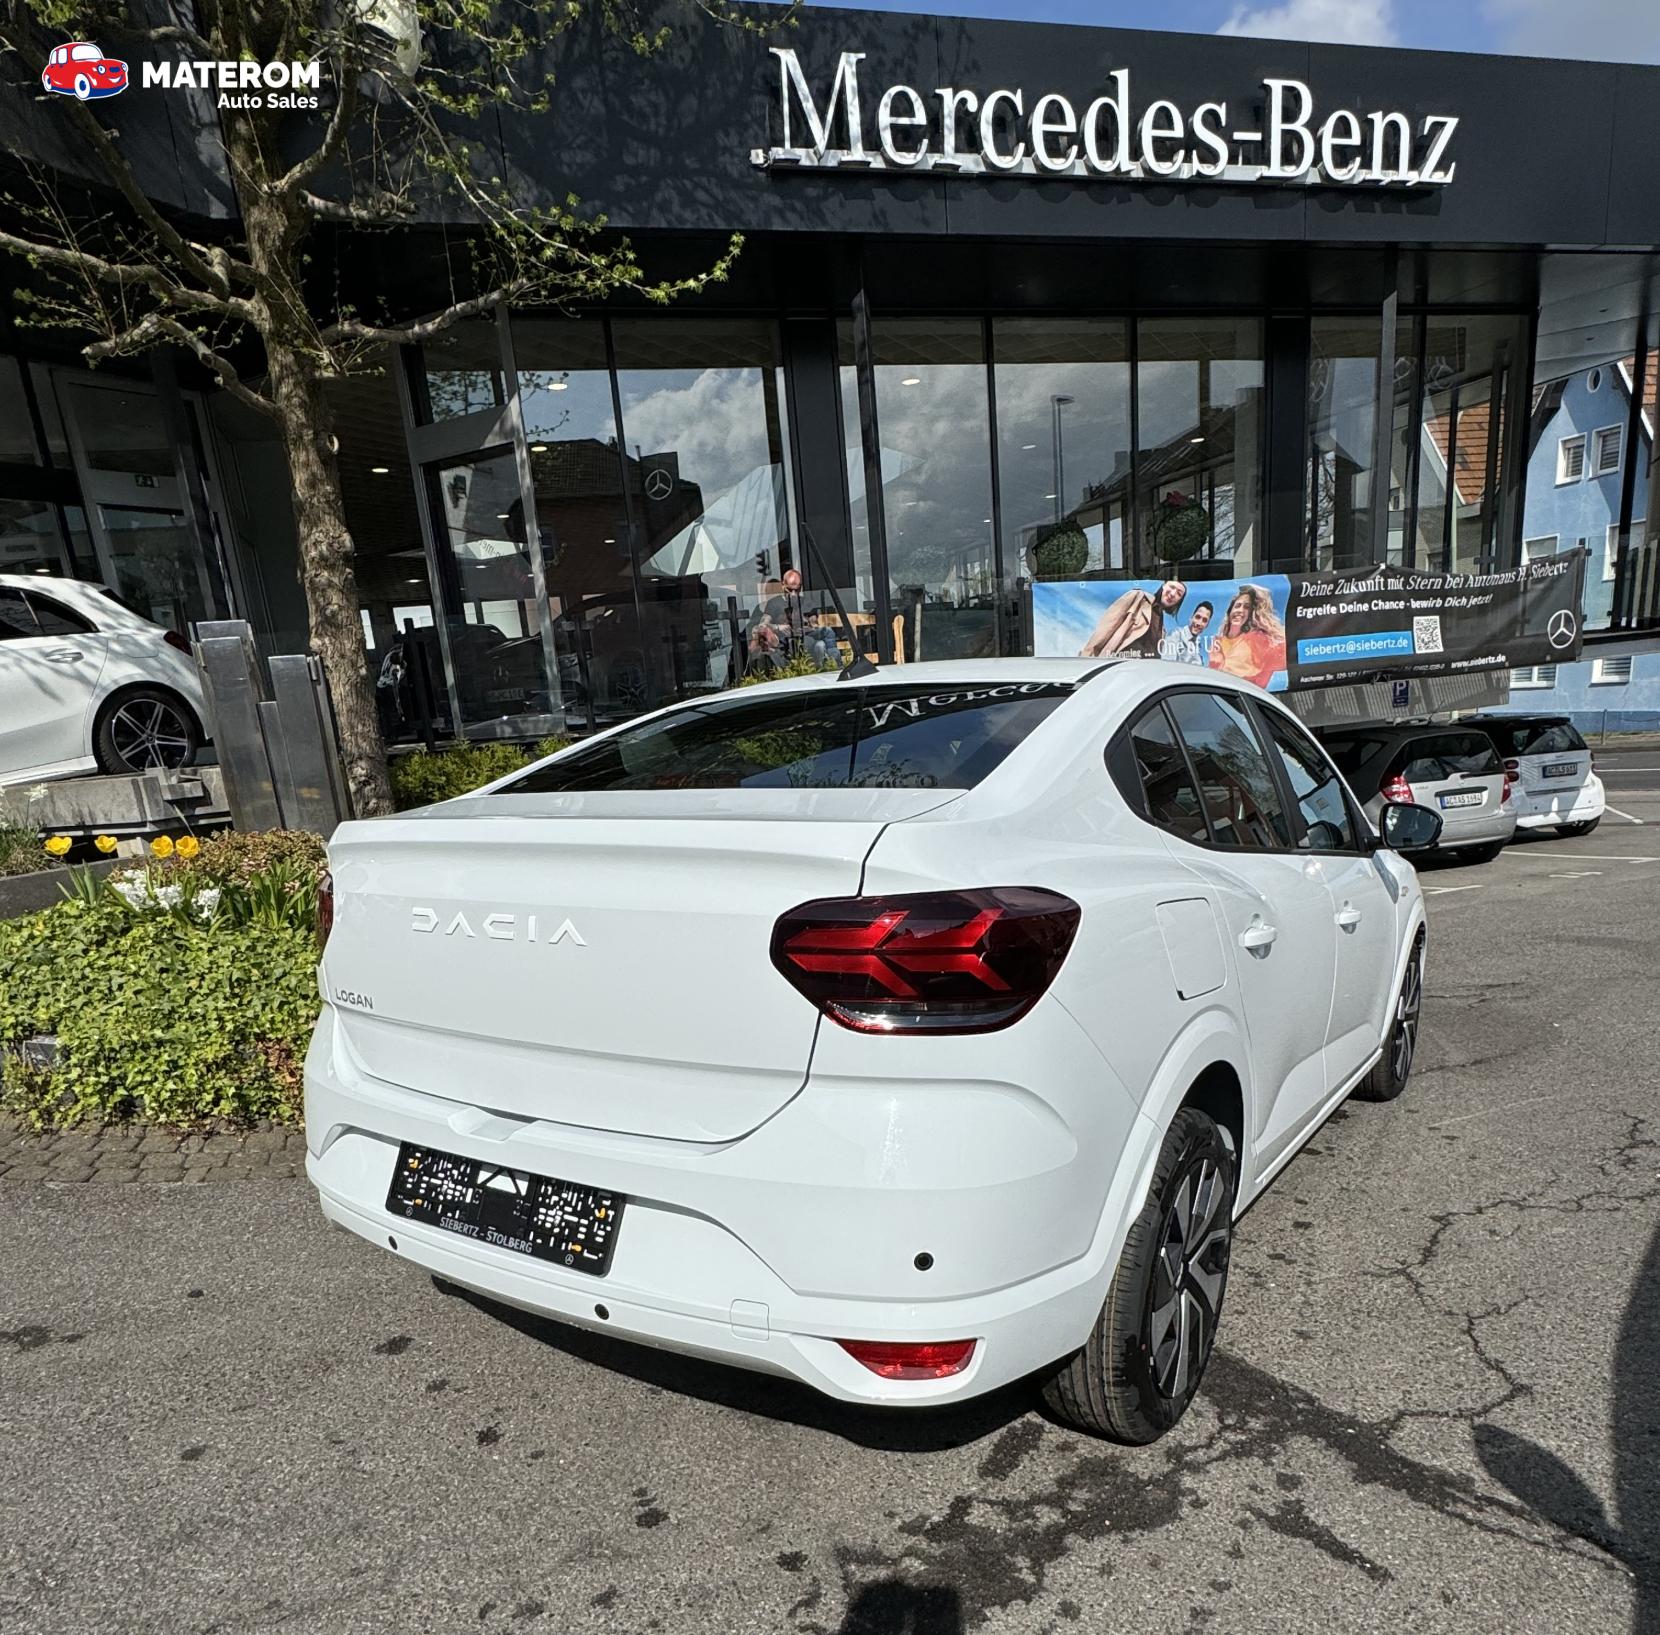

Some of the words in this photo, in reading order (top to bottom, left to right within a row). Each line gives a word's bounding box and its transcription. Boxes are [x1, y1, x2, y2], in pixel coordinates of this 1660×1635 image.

[769, 47, 1459, 184] Mercedes-Benz
[1300, 580, 1334, 598] Deine
[1335, 575, 1385, 595] Zukunft
[1387, 574, 1405, 591] mit
[1407, 575, 1442, 593] Stern
[1444, 574, 1464, 590] bei
[1296, 603, 1337, 619] Ergreife
[1340, 602, 1370, 614] Deine
[1371, 599, 1405, 611] Chance
[1410, 597, 1442, 609] bewirb
[1444, 595, 1467, 607] Dich
[1157, 638, 1185, 656] One
[1187, 636, 1201, 654] of
[1204, 635, 1221, 653] Us
[1304, 636, 1409, 657] siebertz@siebertz.de
[1395, 681, 1407, 696] P
[411, 906, 588, 948] DACIA
[334, 987, 374, 1010] LOGAN
[439, 1216, 480, 1238] SIEBERTZ
[485, 1230, 533, 1254] STOLBERG
